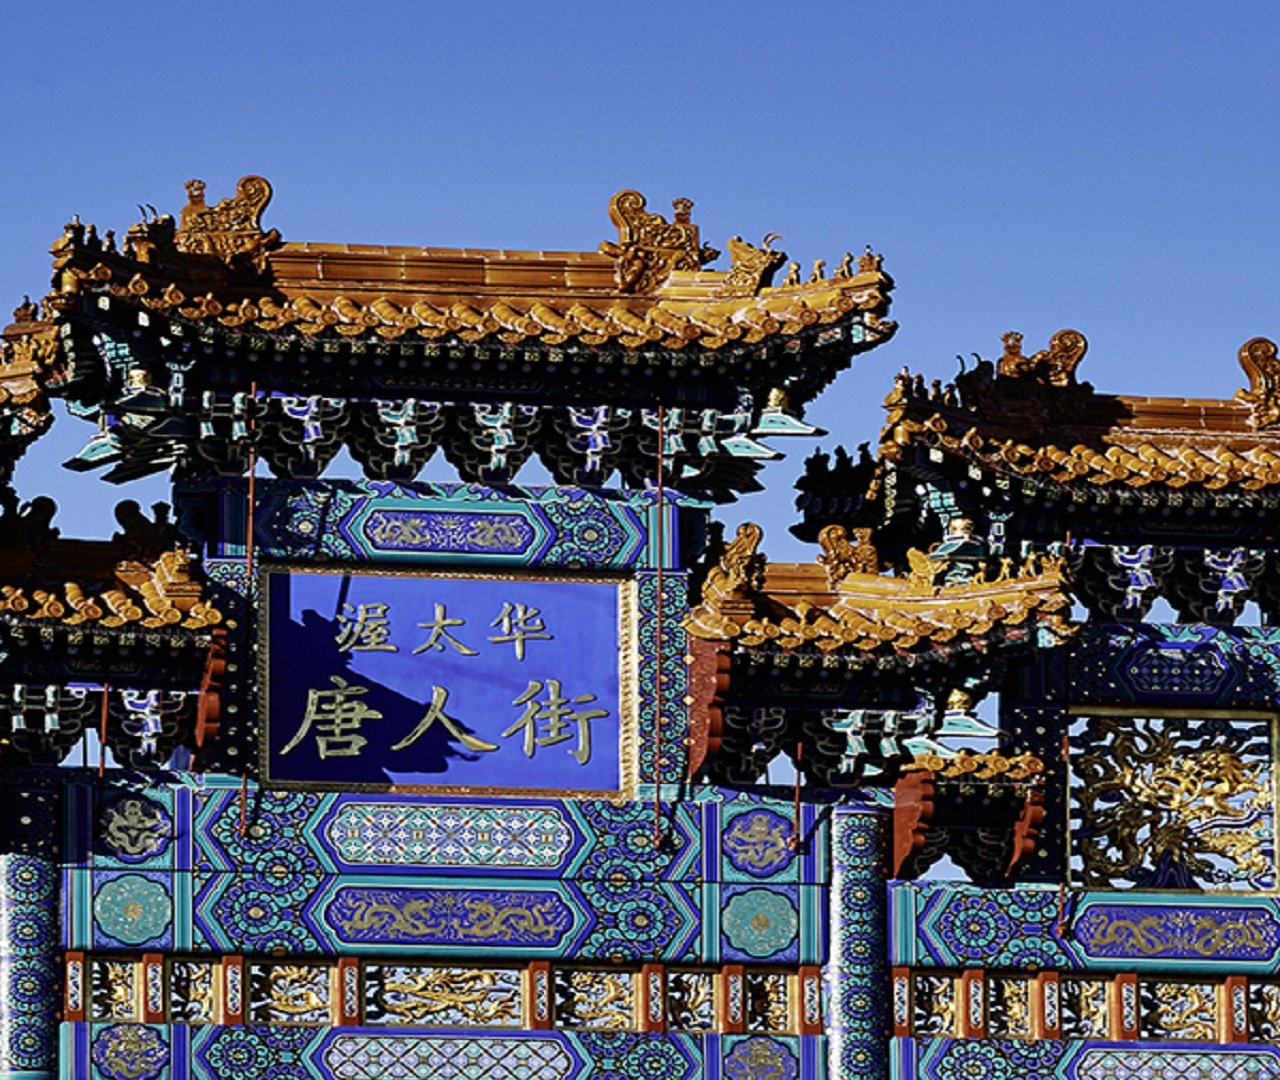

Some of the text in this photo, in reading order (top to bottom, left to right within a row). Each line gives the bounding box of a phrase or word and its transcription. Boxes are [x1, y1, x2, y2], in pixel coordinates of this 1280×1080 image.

[334, 602, 554, 661] 渥太华
[279, 675, 610, 765] 唐人街
